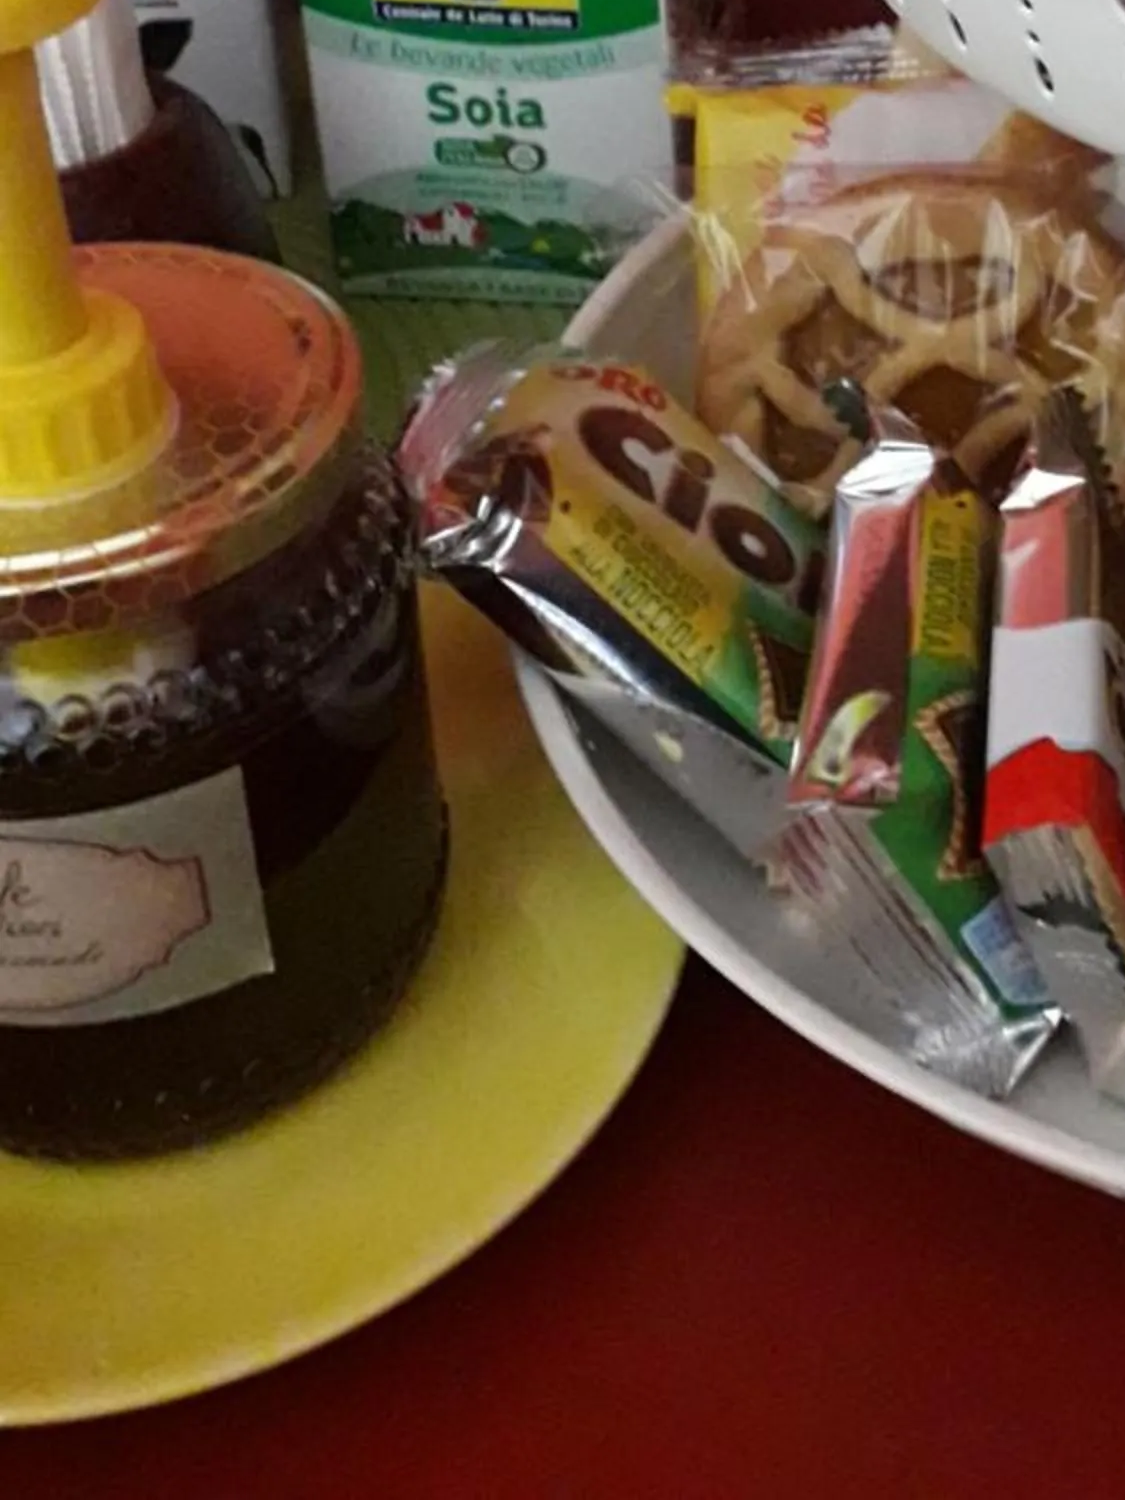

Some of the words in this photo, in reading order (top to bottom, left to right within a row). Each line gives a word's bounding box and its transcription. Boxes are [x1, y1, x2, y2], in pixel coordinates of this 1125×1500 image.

[389, 39, 504, 73] bevande
[510, 42, 617, 80] vegetali
[425, 82, 547, 130] Soia
[577, 404, 824, 610] Cio
